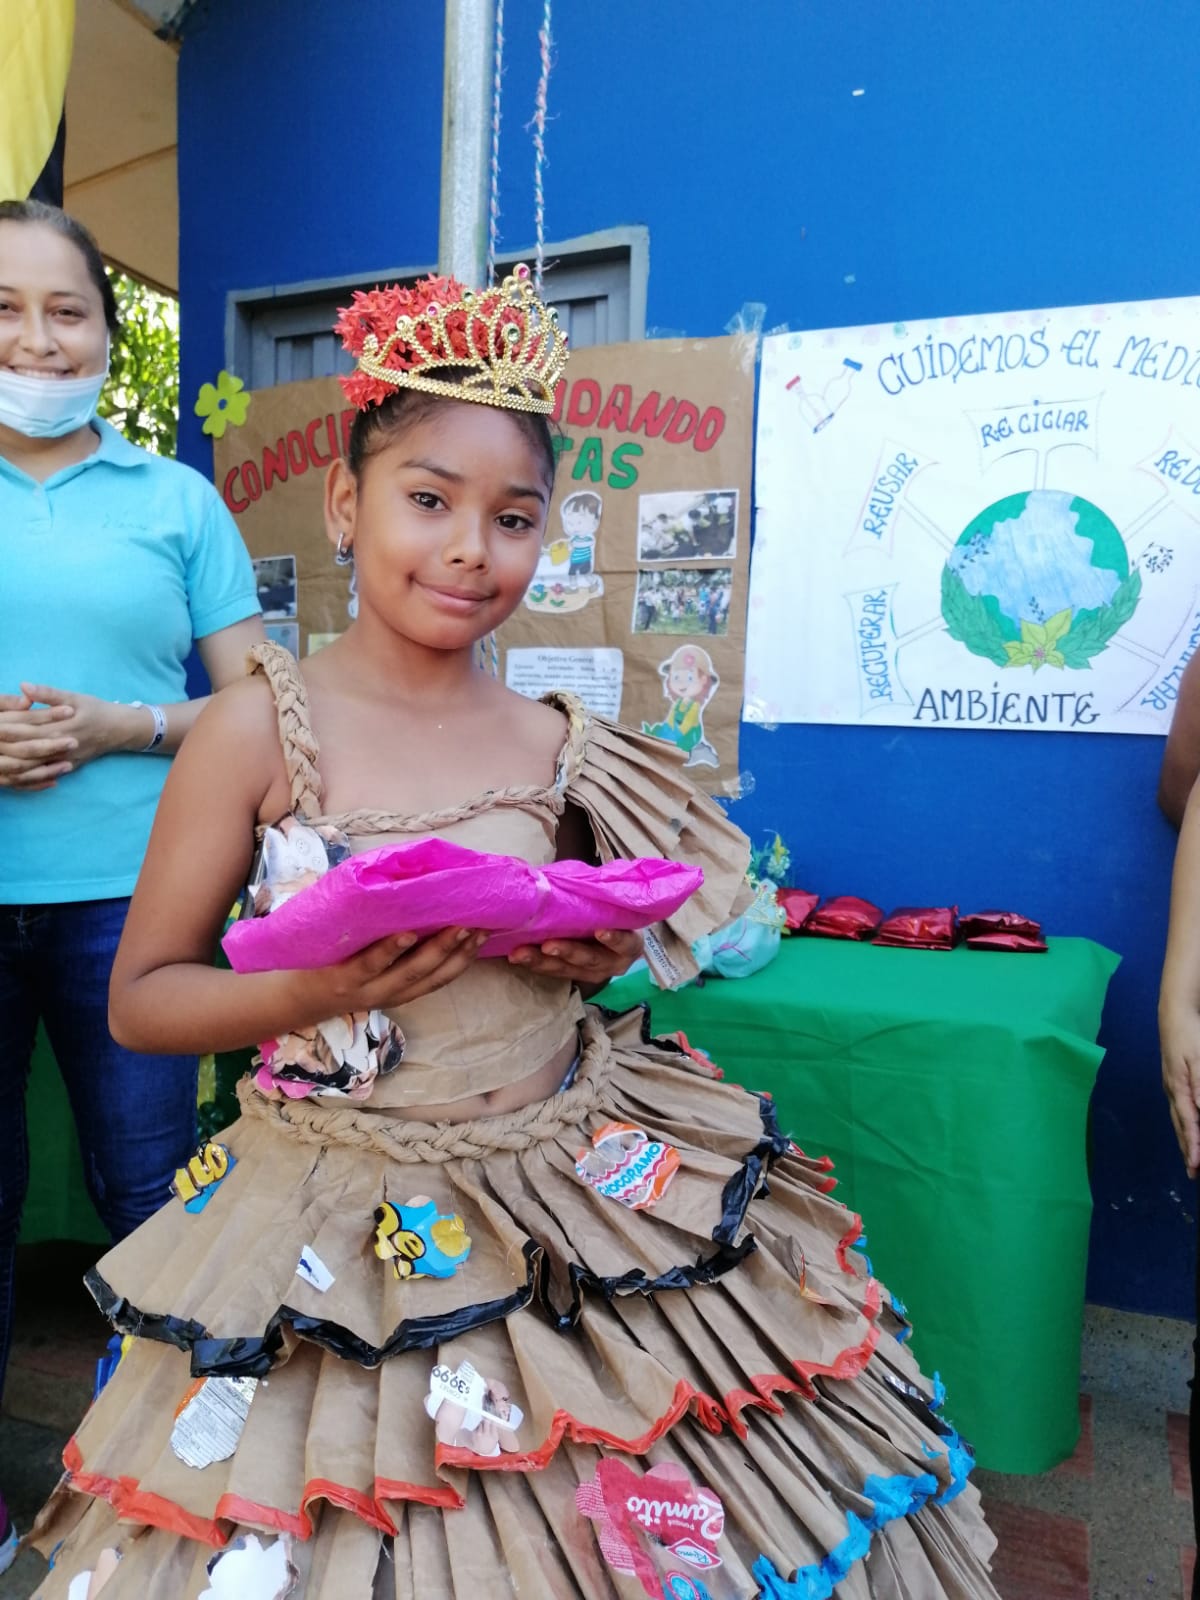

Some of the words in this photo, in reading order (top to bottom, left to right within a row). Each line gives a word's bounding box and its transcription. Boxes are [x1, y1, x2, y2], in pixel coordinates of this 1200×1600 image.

[1061, 329, 1101, 369] EL
[1112, 335, 1200, 389] MEDI
[863, 453, 919, 539] REUSAR
[858, 589, 894, 702] RECUPERAR
[626, 1494, 725, 1541] Ramito
